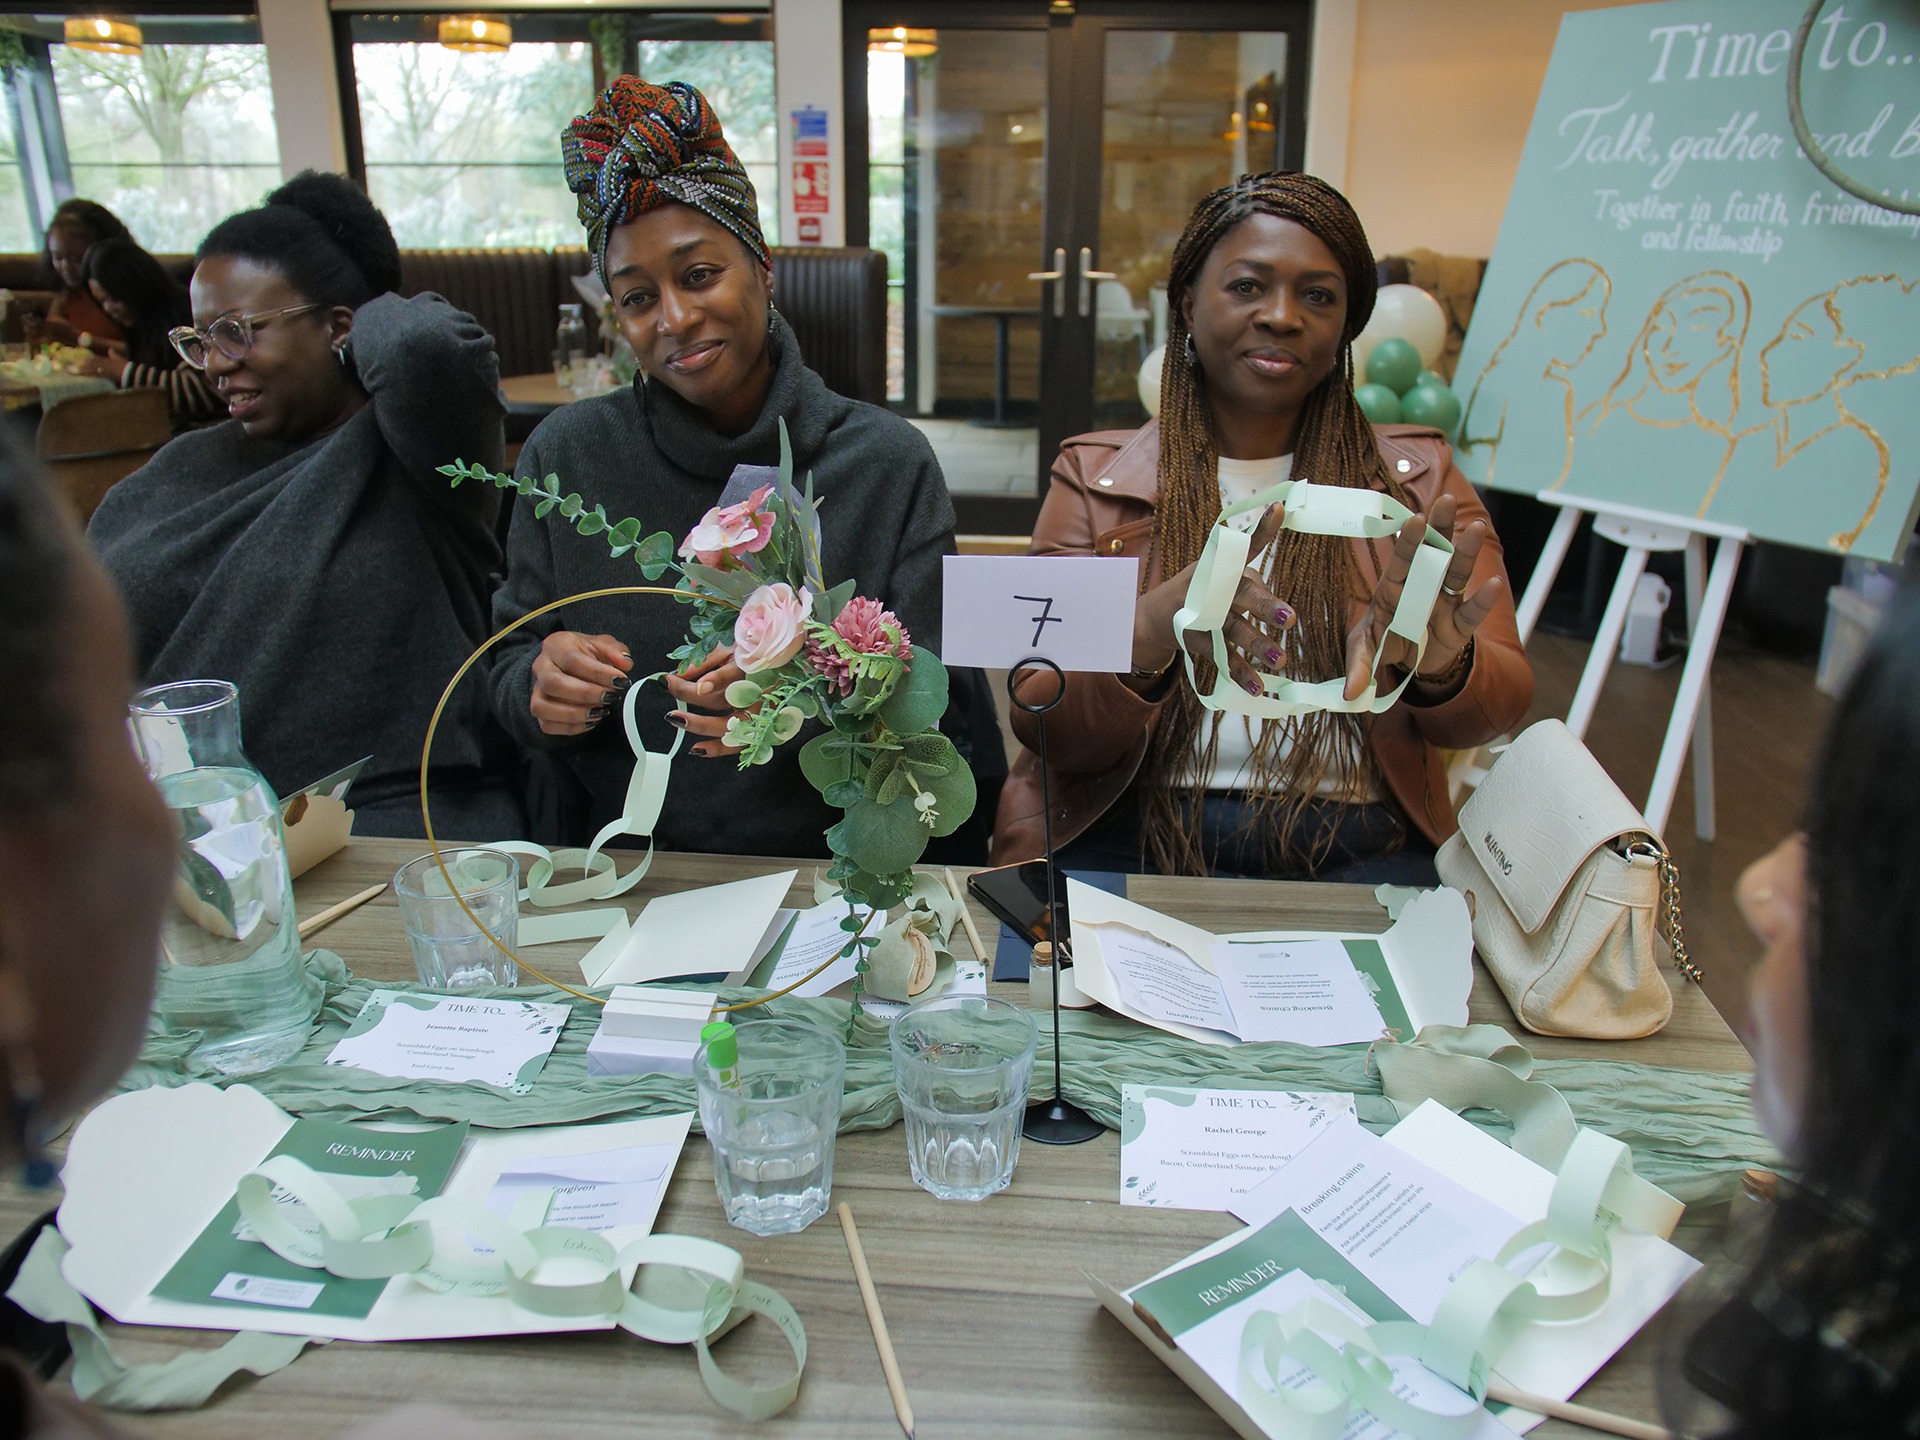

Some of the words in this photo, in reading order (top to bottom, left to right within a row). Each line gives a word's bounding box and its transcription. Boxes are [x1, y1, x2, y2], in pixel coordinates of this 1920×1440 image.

[1648, 21, 1792, 83] Time
[1553, 90, 1660, 171] Talk,
[1651, 111, 1784, 190] gather
[1594, 189, 1684, 231] Together
[1689, 194, 1712, 222] in
[1722, 190, 1789, 227] faith,
[1641, 221, 1684, 251] and
[1684, 222, 1783, 264] fellowship
[1013, 595, 1062, 648] 7
[447, 1003, 479, 1013] TIME
[426, 1023, 457, 1031] Jeanette
[1207, 1097, 1243, 1108] TIME
[1204, 1126, 1233, 1134] Rachel
[1235, 1127, 1267, 1136] George
[325, 1142, 416, 1161] REMINDER
[1180, 1149, 1220, 1157] Scrambled
[1221, 1151, 1240, 1160] Eggs
[1186, 1161, 1233, 1170] Cumberland
[1300, 1185, 1341, 1214] Breaking
[1336, 1162, 1365, 1186] chains
[1198, 1259, 1284, 1307] REMINDER
